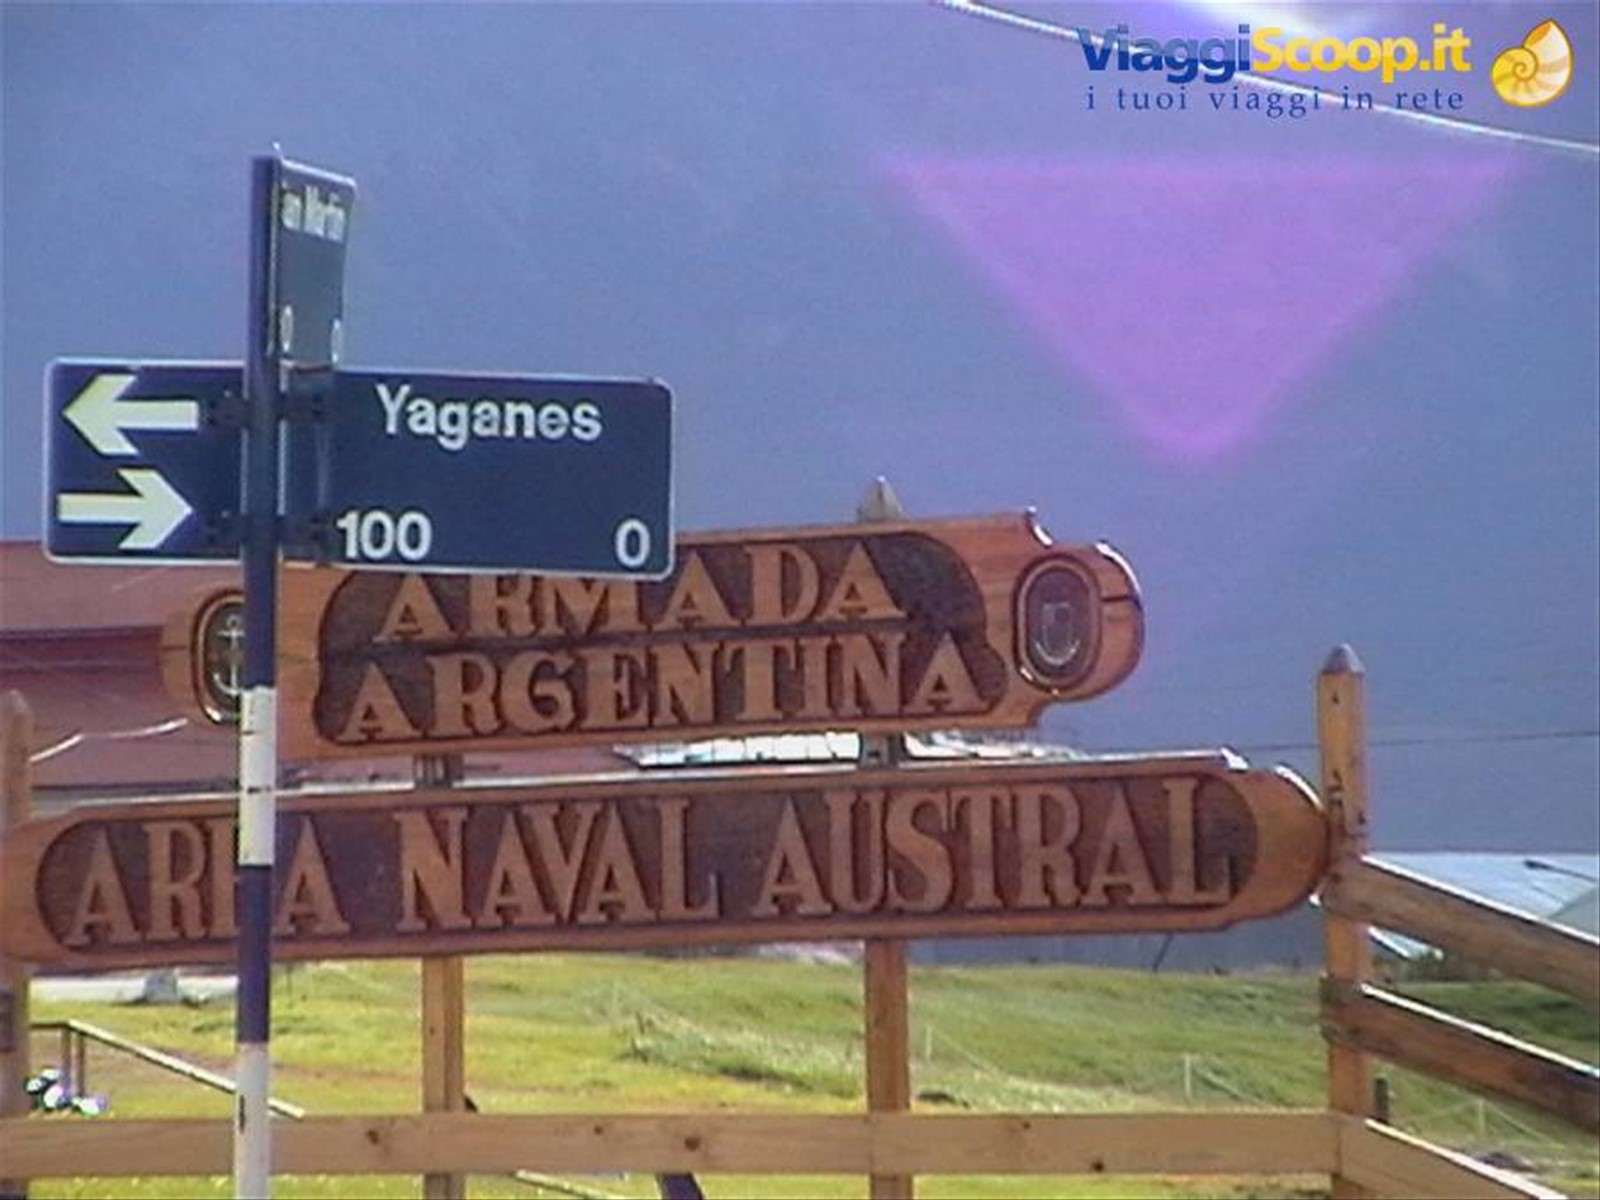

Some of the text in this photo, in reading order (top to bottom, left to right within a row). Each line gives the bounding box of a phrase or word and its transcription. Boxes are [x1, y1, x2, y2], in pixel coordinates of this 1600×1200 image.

[375, 382, 602, 451] Yaganes
[337, 510, 650, 568] 100 0
[372, 541, 907, 643] ARMADA
[337, 630, 989, 743] ARGENTINA
[396, 797, 719, 932] NAVAL
[751, 775, 1231, 915] AUSTRAL
